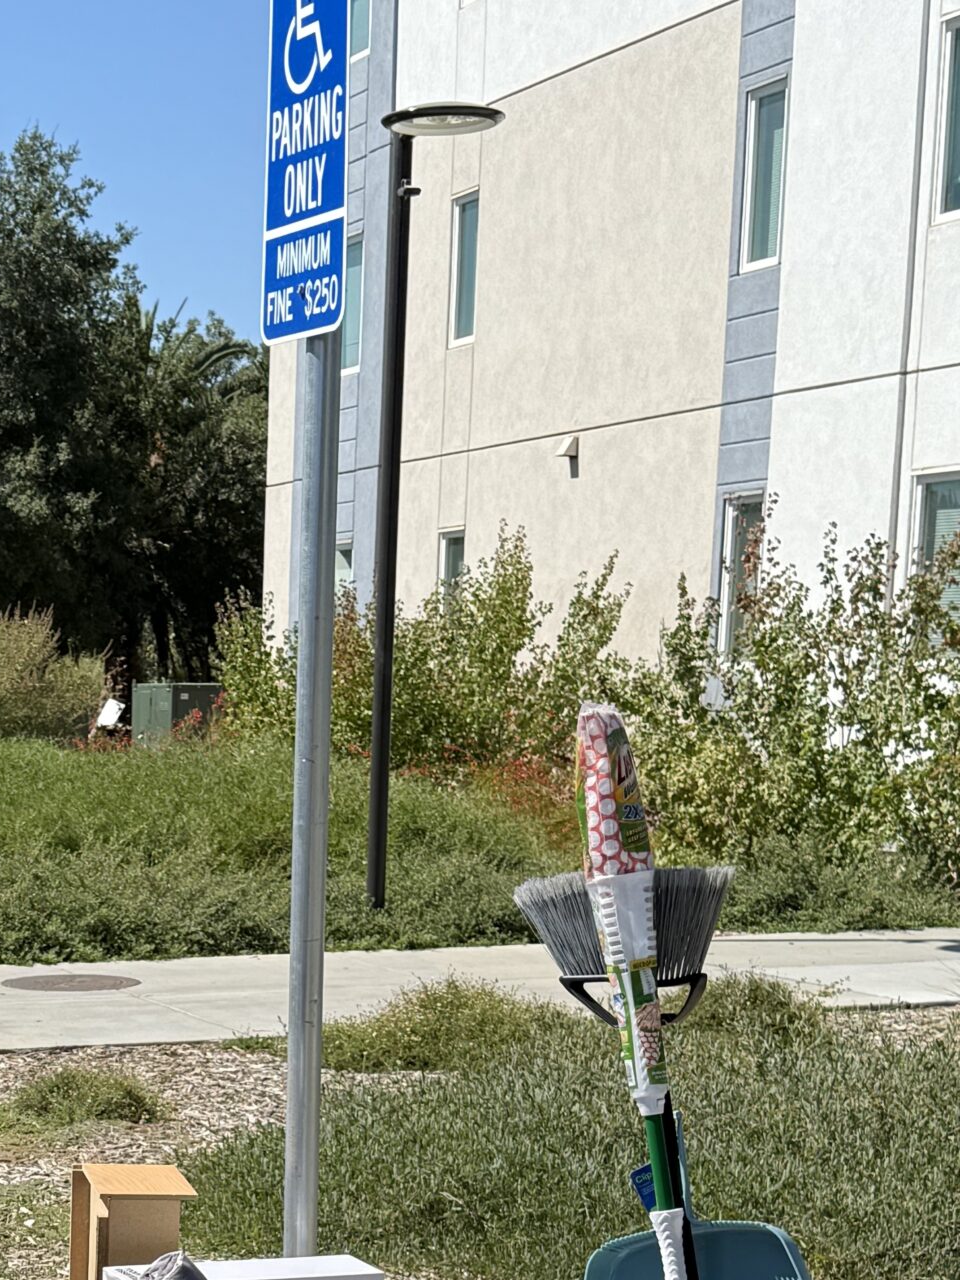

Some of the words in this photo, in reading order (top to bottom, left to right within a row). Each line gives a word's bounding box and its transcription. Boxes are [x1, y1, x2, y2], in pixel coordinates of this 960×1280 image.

[271, 85, 343, 162] PARKING
[284, 153, 327, 217] ONLY
[276, 230, 331, 279] MINIMUM
[266, 286, 293, 326] FINE
[304, 278, 339, 320] $250
